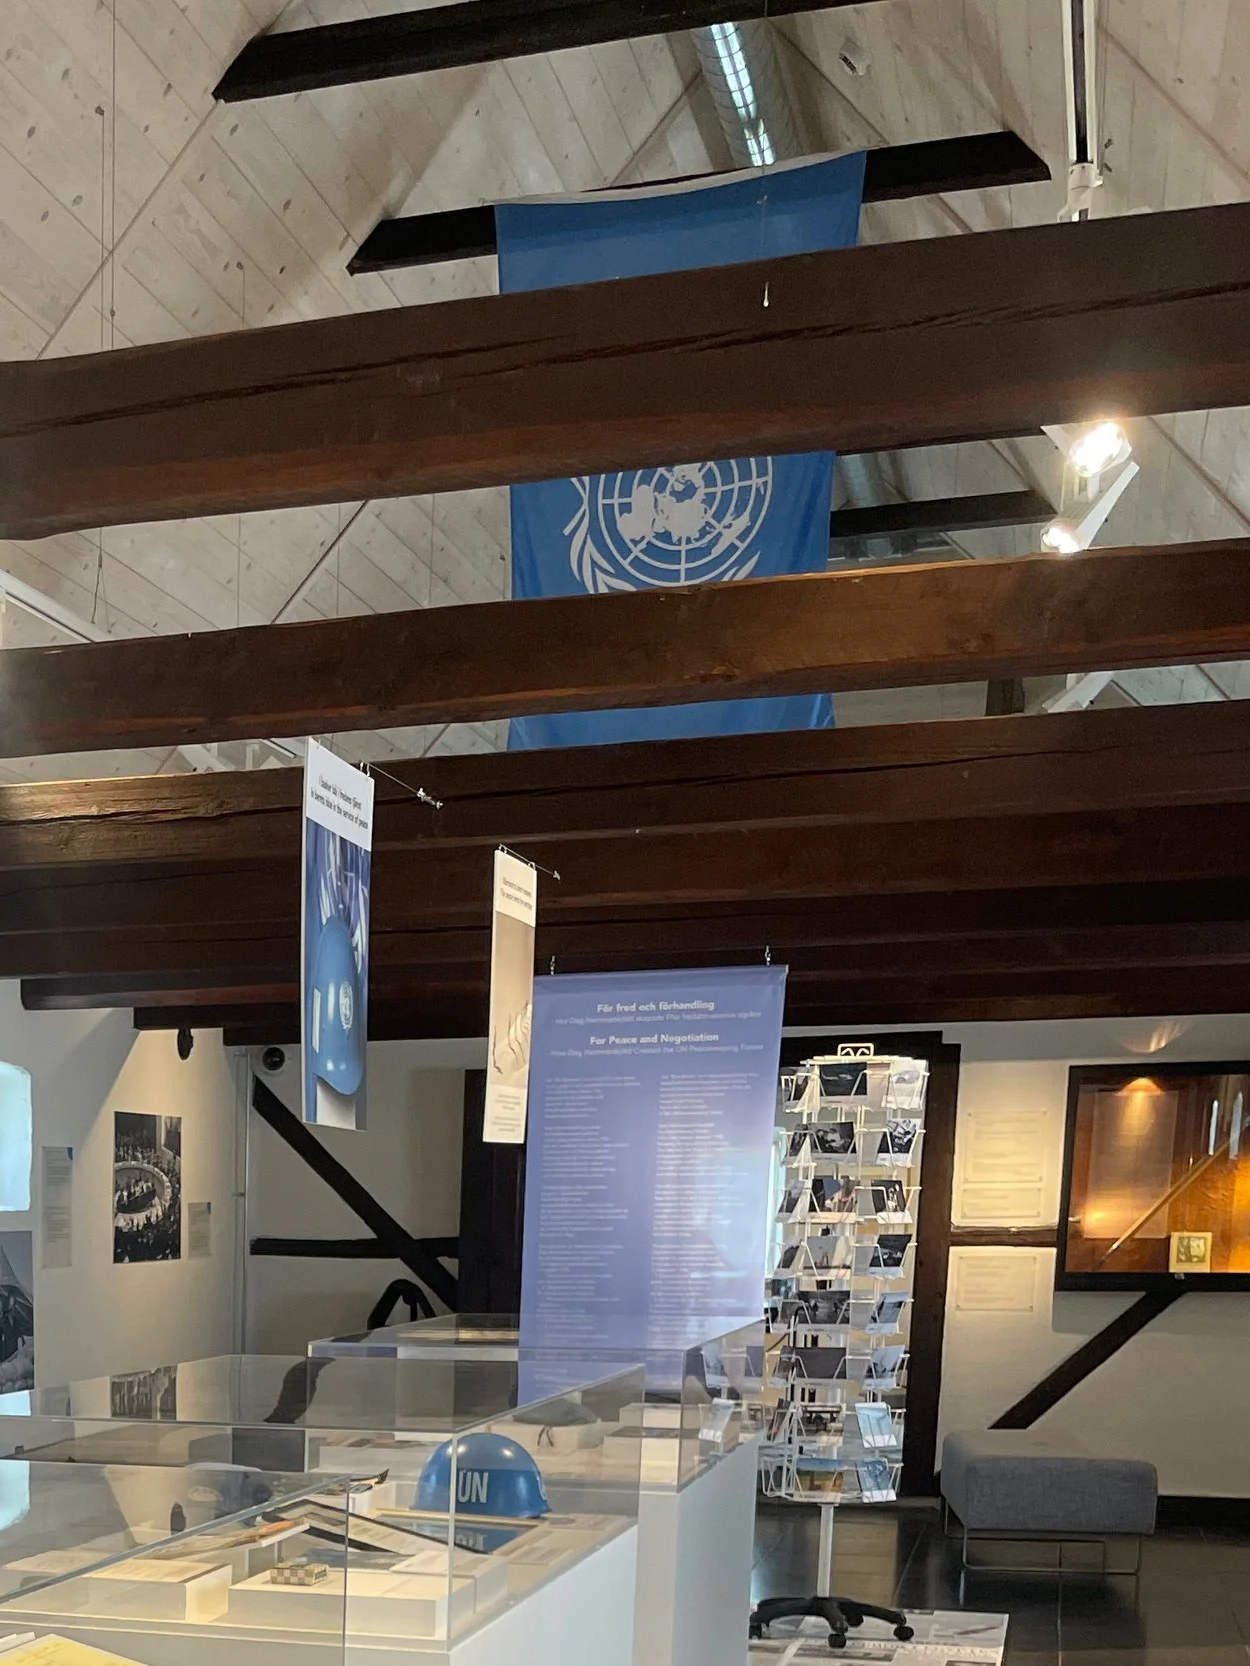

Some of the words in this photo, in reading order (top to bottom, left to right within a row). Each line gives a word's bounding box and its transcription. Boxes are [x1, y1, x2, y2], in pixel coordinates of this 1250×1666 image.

[597, 1003, 613, 1013] För
[616, 1002, 636, 1012] fred
[639, 1002, 657, 1011] och
[659, 1000, 715, 1011] förhandling
[590, 1036, 607, 1045] For
[609, 1035, 637, 1045] Peace
[639, 1034, 658, 1043] and
[660, 1033, 718, 1045] Negotiation
[458, 1471, 489, 1503] UN
